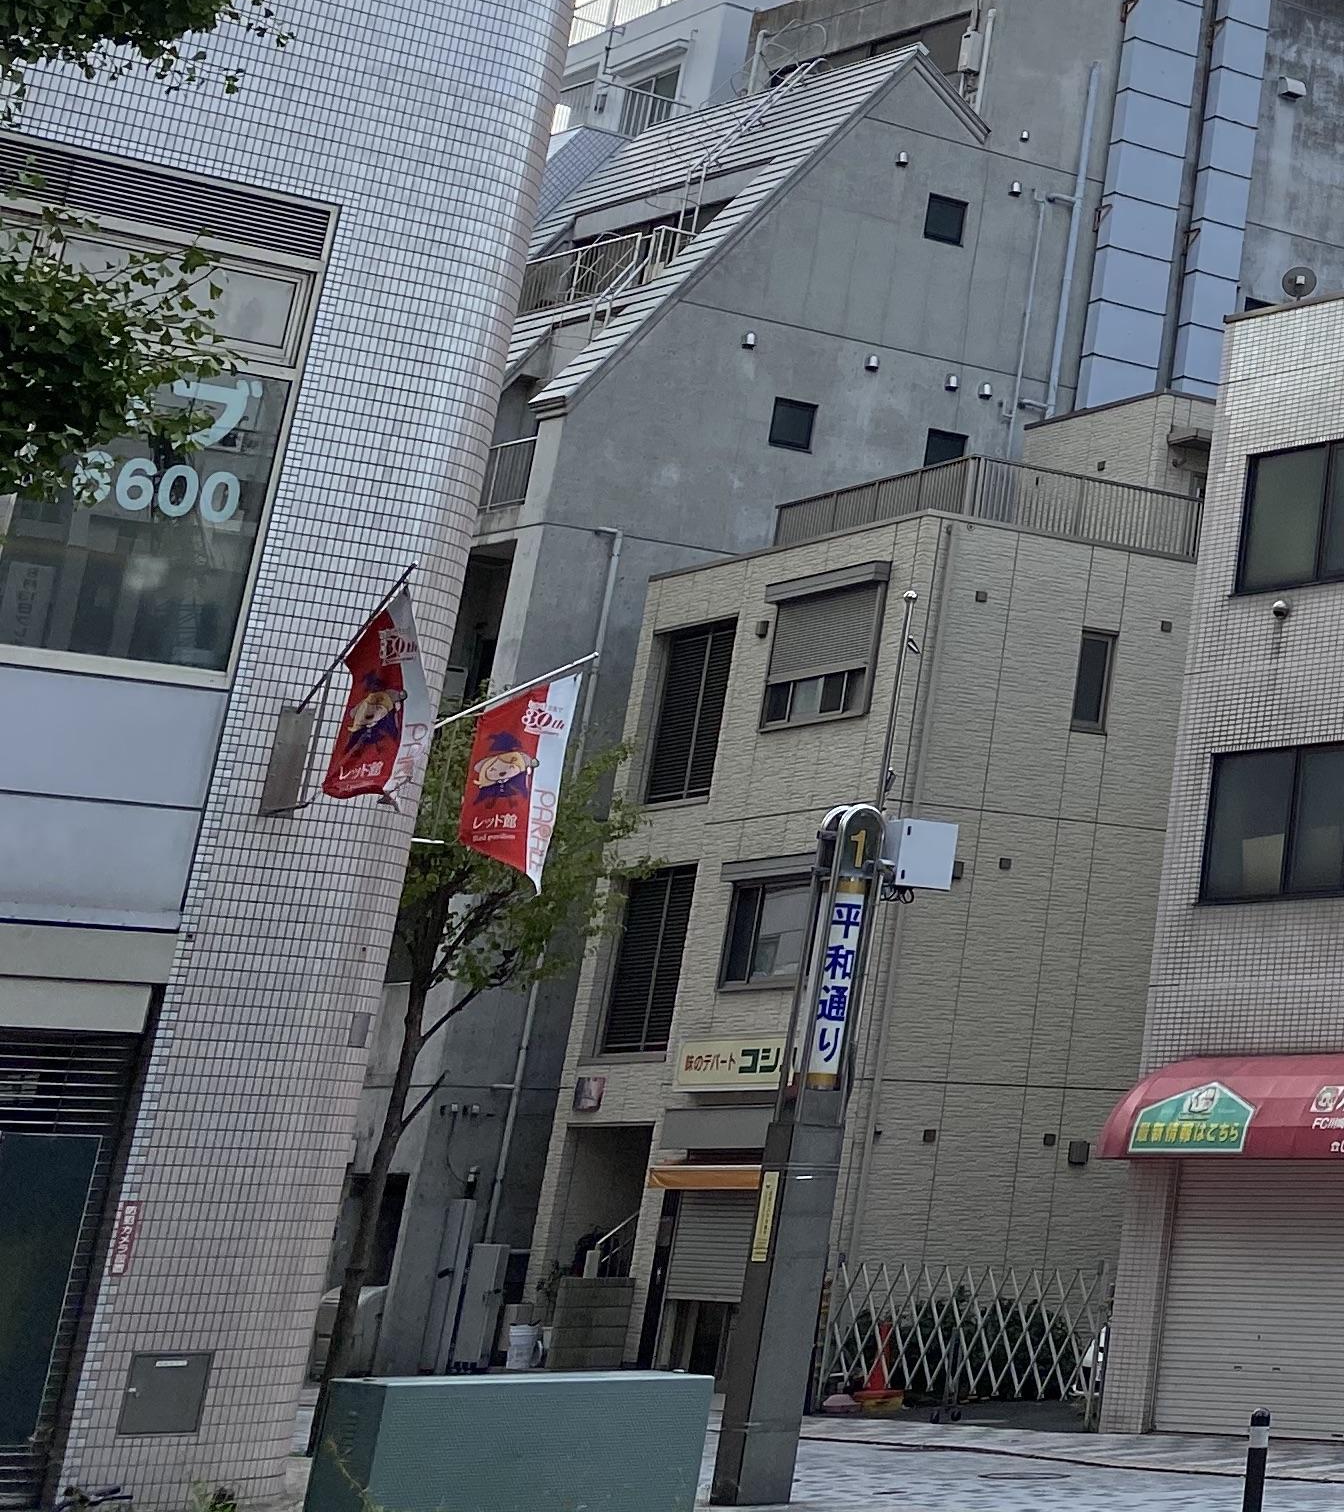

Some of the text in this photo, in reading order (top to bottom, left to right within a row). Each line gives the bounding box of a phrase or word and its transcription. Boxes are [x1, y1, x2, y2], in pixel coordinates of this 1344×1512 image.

[850, 829, 867, 868] 1
[816, 903, 862, 1063] 平和通り
